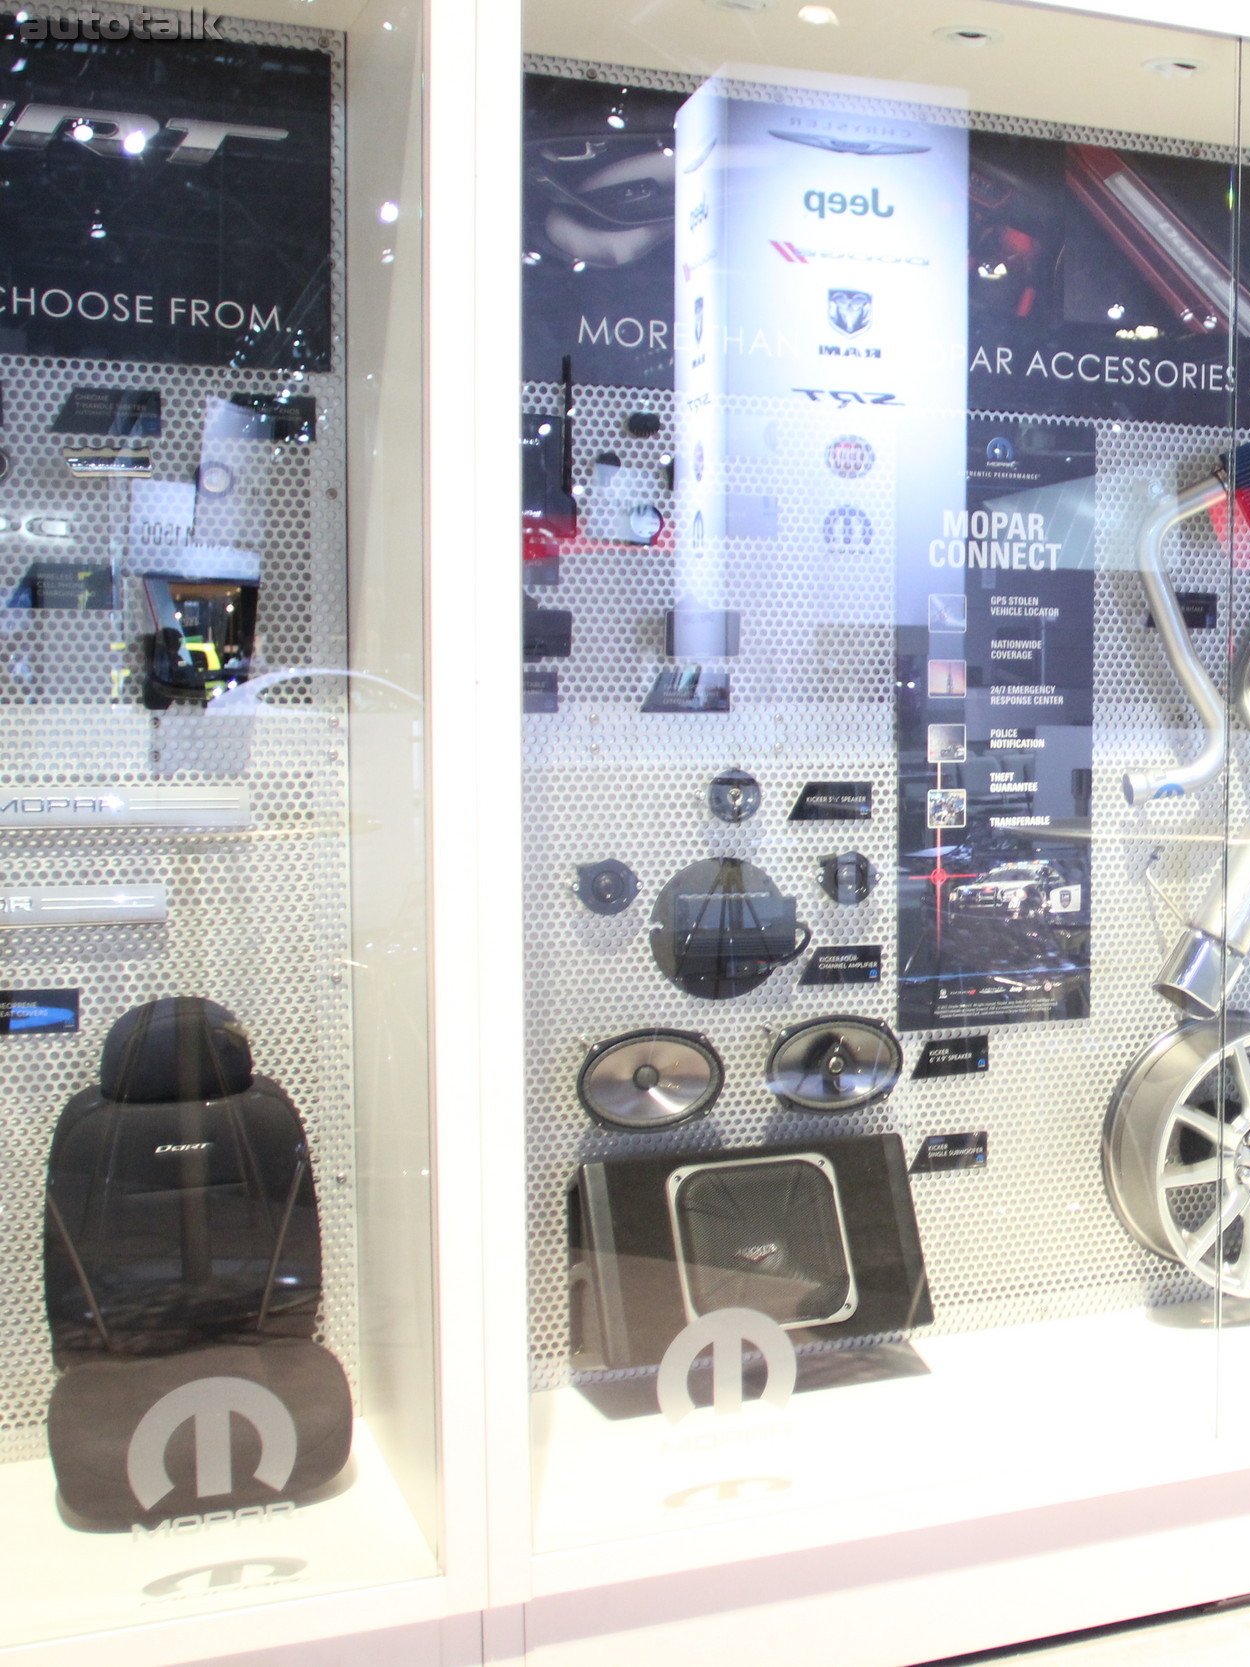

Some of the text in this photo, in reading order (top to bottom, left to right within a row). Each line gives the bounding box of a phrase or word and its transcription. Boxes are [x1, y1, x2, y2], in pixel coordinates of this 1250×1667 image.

[0, 285, 292, 332] HOOSE FROM.
[1026, 350, 1237, 393] ACCESSORIES
[942, 508, 1046, 541] MOPAR
[928, 538, 1063, 572] CONNECT
[990, 595, 1039, 606] GPS STOLEN
[990, 606, 1060, 617] VEHICLE LOCATOR
[990, 639, 1043, 650] NATIONWIDE
[990, 650, 1034, 660] COVERAGE
[990, 685, 1057, 696] 24/7 EMERGENCY
[990, 695, 1065, 706] RESPONSE CENTER
[990, 728, 1019, 739] POLICE
[990, 738, 1046, 749] NOTIFICATION
[990, 772, 1015, 782] THEFT
[989, 781, 1039, 793] GUARANTEE
[989, 815, 1051, 828] TRANSFERABLE
[131, 1501, 297, 1543] MOPAR
